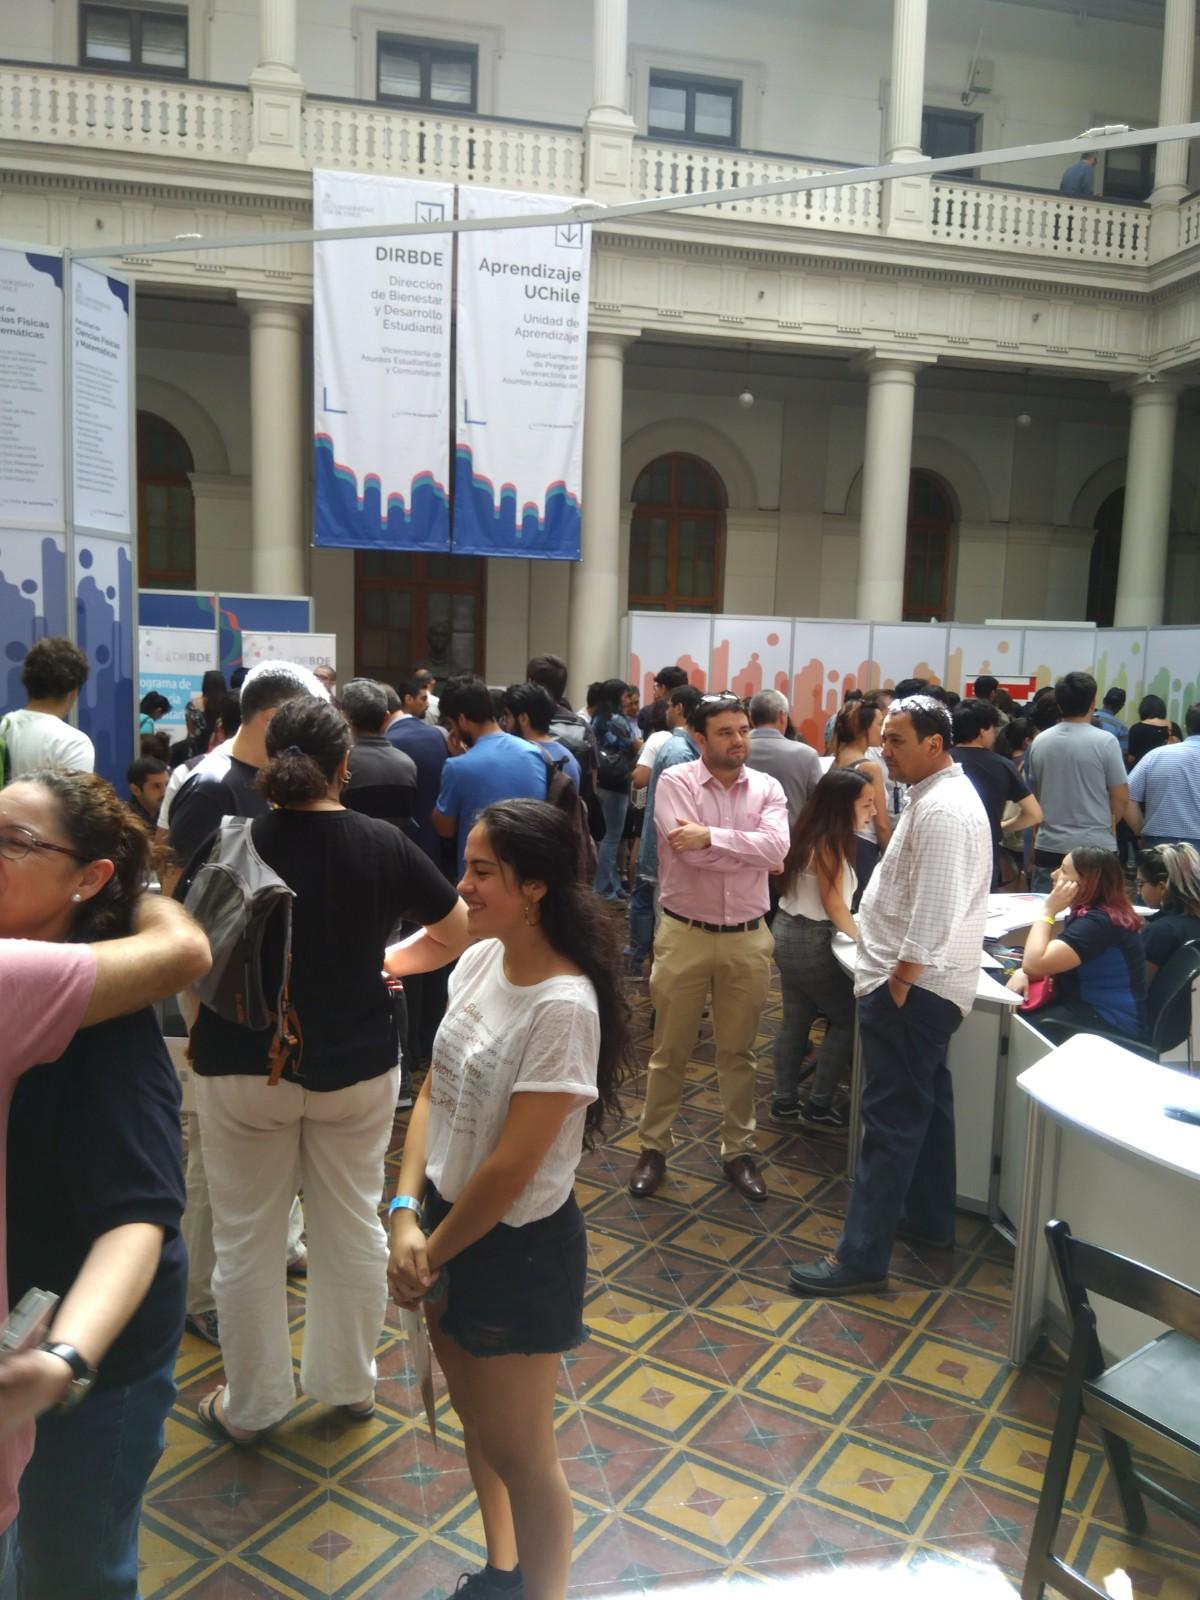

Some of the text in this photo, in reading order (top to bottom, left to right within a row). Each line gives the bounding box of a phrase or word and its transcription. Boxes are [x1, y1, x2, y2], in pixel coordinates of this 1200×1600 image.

[375, 246, 443, 267] DIRBDE
[479, 257, 581, 284] Aprendizaje
[389, 275, 443, 291] Dirección
[370, 289, 442, 305] de Bienestar
[524, 284, 580, 304] UChile
[374, 304, 442, 321] y Desarrollo
[523, 313, 580, 328] Unidad de
[383, 319, 443, 335] Estudiantil
[514, 327, 579, 344] Aprendizaje
